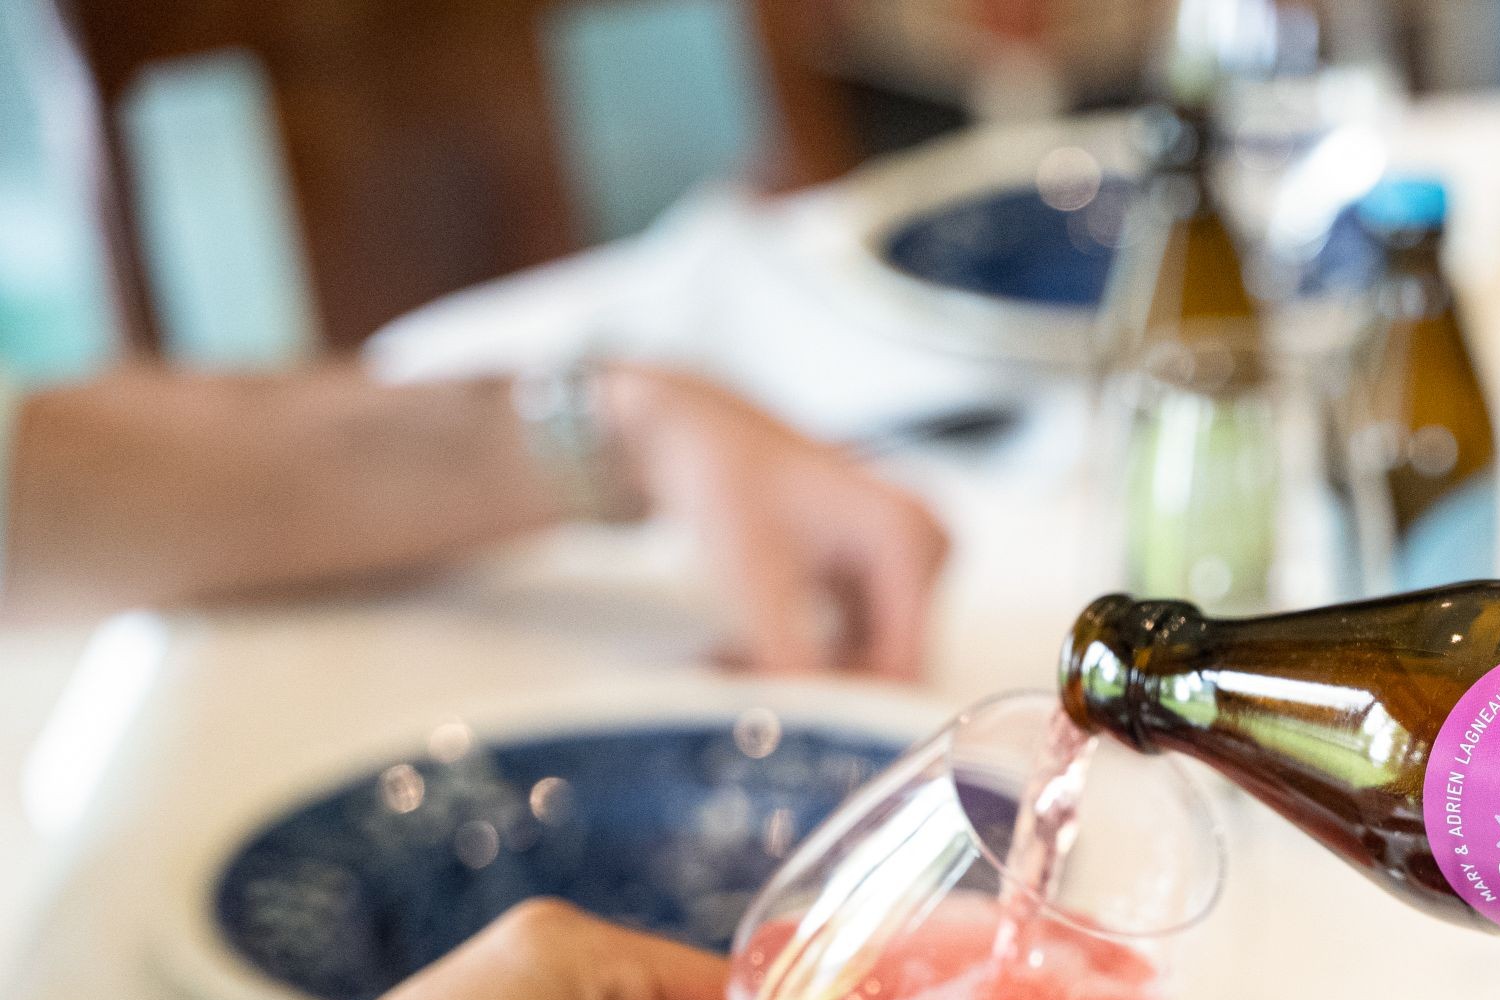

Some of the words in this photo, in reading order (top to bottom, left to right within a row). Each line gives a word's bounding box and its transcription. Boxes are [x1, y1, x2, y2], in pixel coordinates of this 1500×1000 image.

[1446, 771, 1465, 837] ADRIEN
[1455, 844, 1469, 854] &
[1461, 862, 1497, 902] MARY
